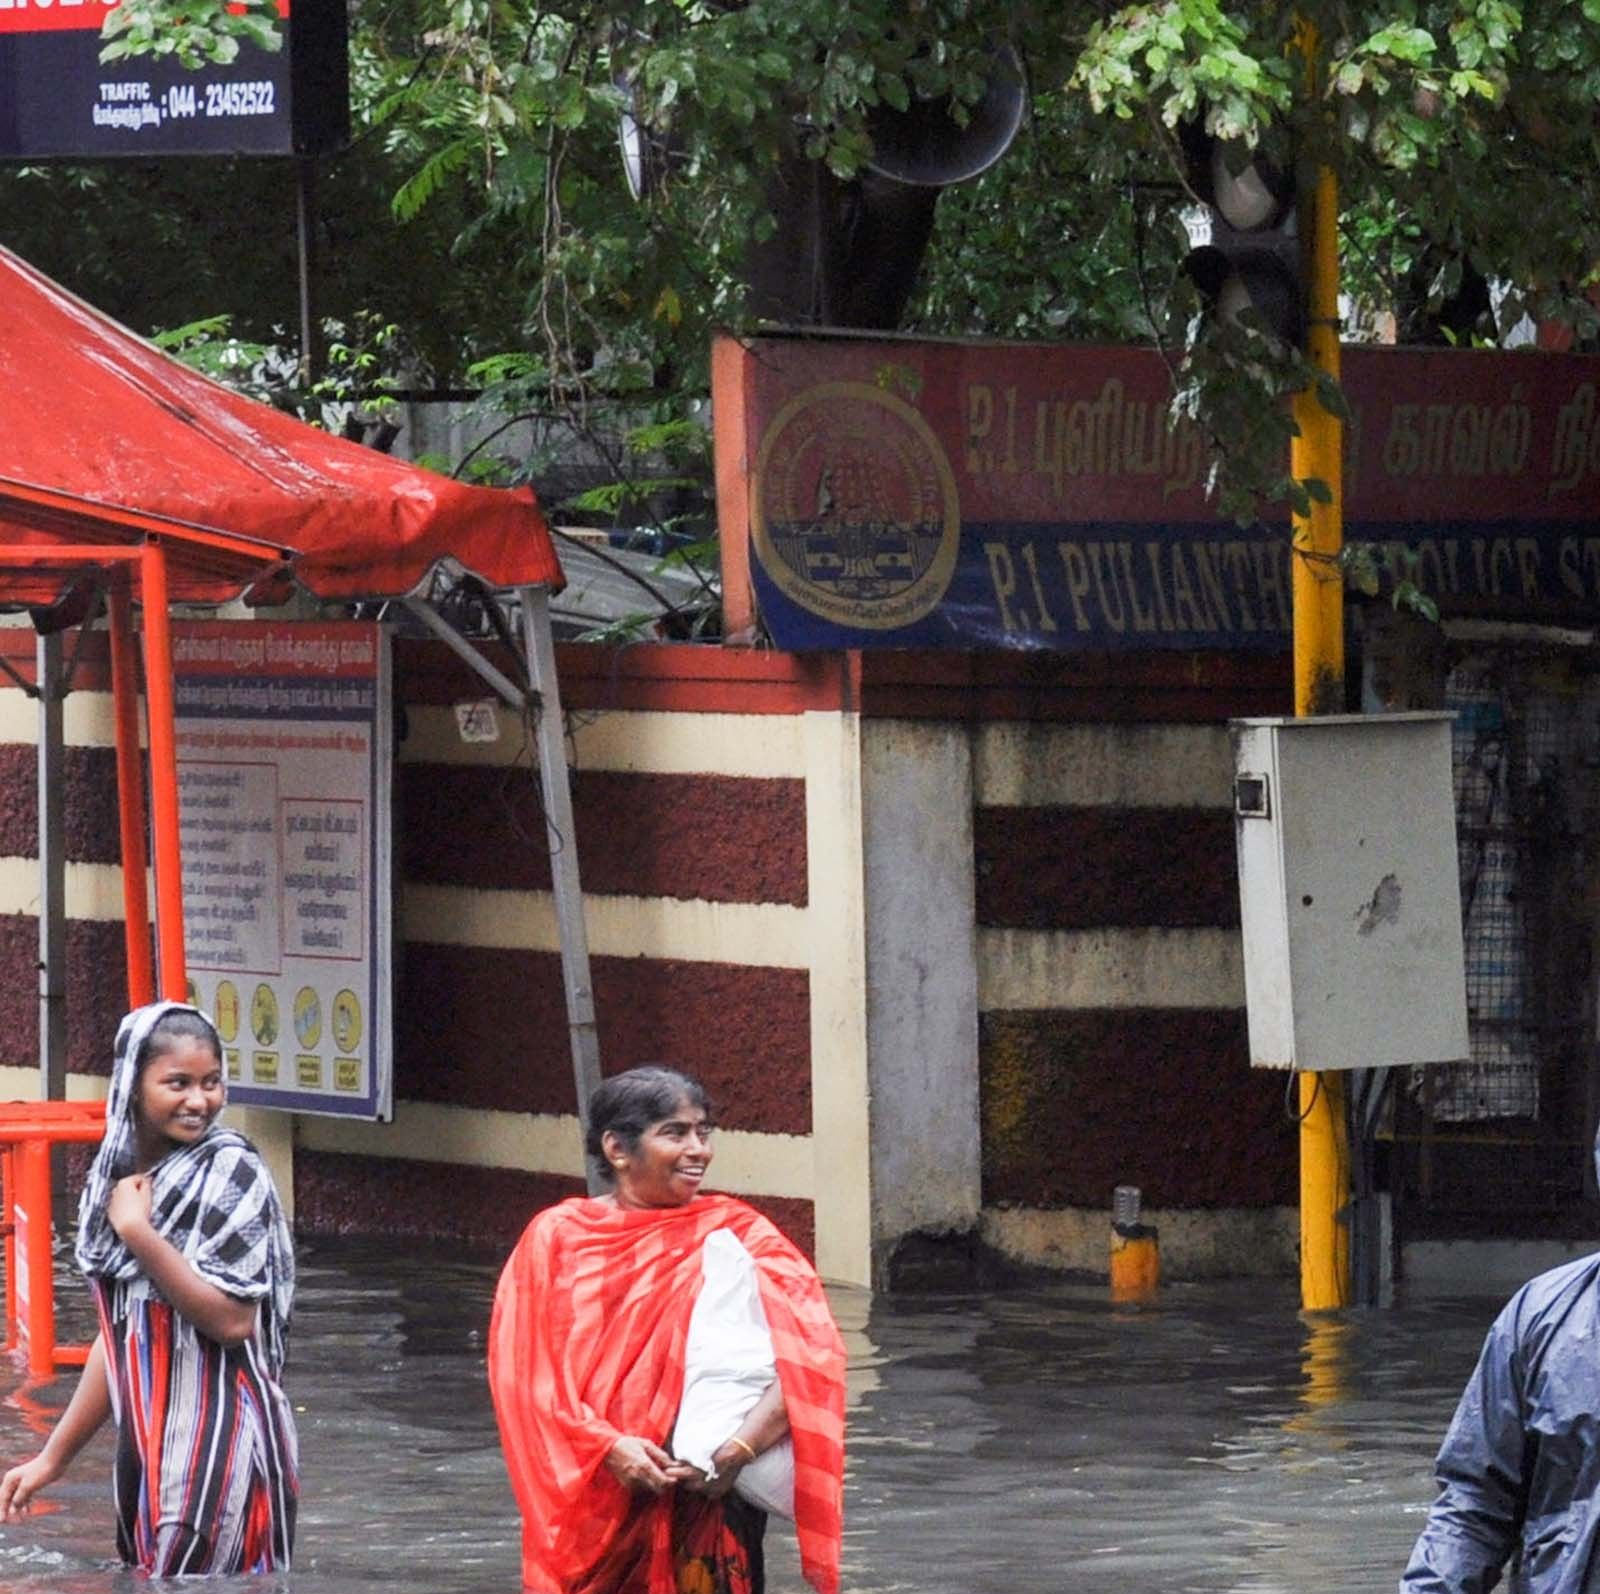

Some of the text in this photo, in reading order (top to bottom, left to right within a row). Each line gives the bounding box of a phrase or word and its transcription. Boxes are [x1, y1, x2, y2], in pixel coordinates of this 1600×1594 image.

[99, 82, 150, 101] TRAFFIC
[169, 86, 196, 118] 044
[206, 81, 274, 116] 23452522
[985, 541, 1056, 631] P.1
